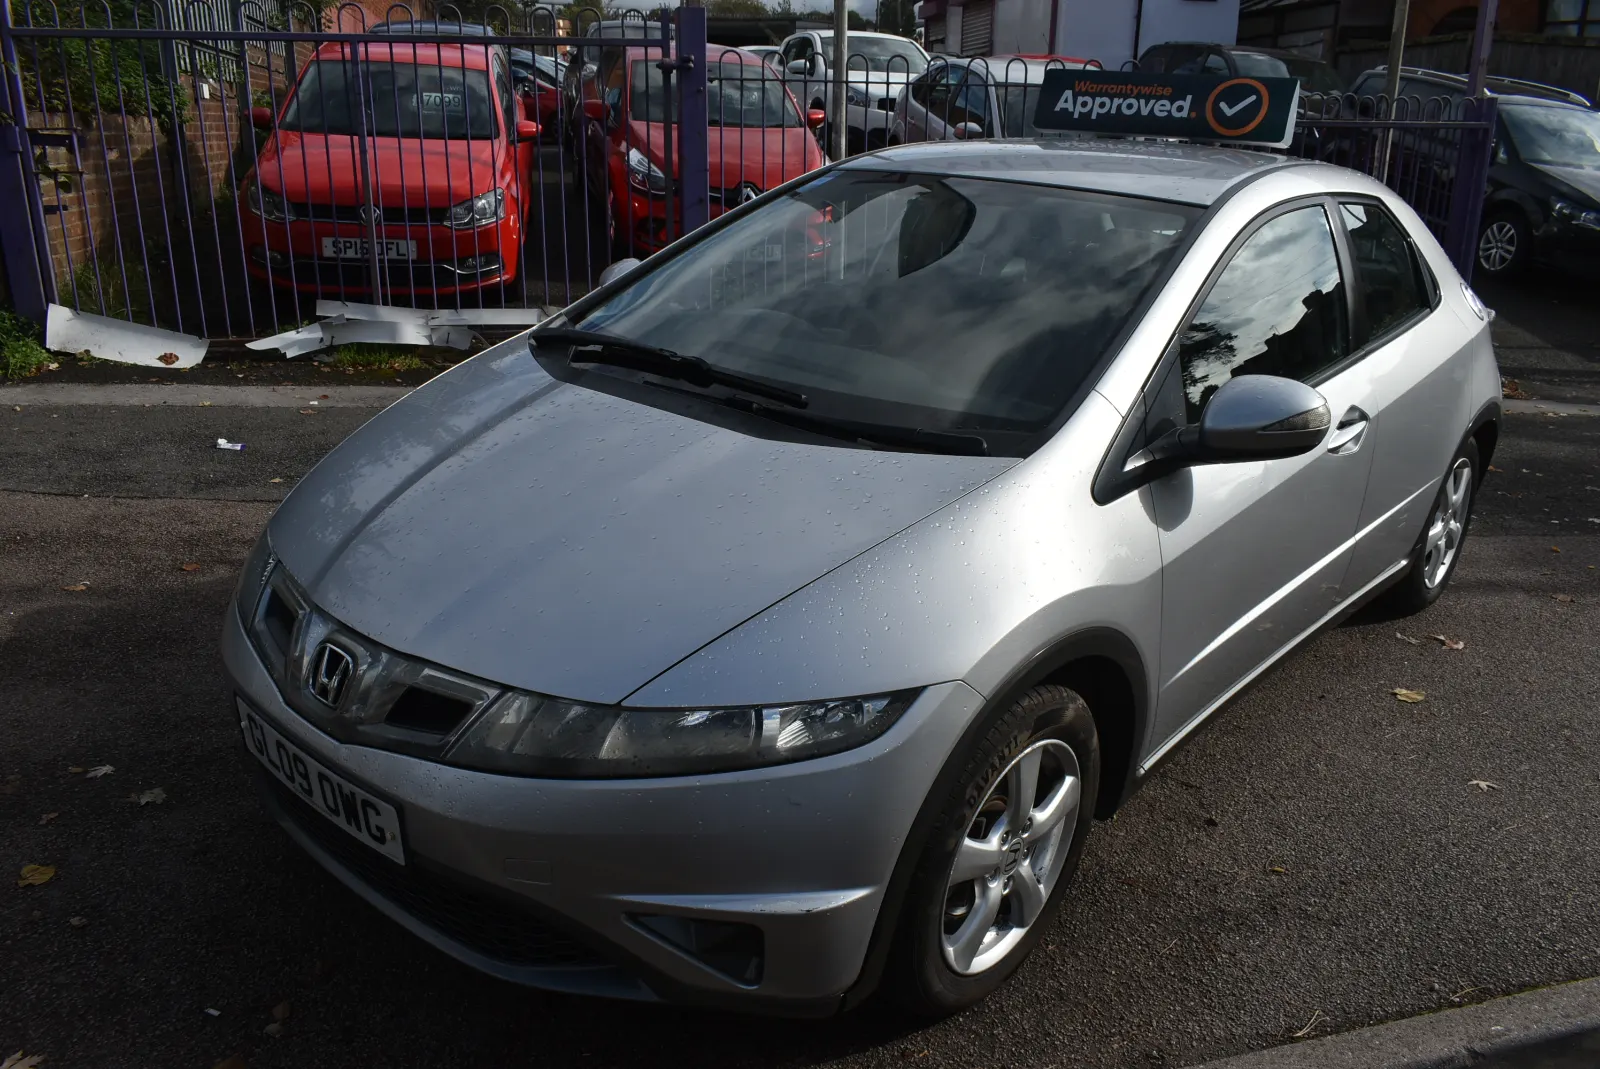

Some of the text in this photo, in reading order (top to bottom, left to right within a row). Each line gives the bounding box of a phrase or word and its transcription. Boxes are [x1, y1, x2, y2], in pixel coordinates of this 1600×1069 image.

[1074, 80, 1173, 97] Warrantywise
[1054, 90, 1197, 119] Approved.
[247, 713, 313, 798] GL09
